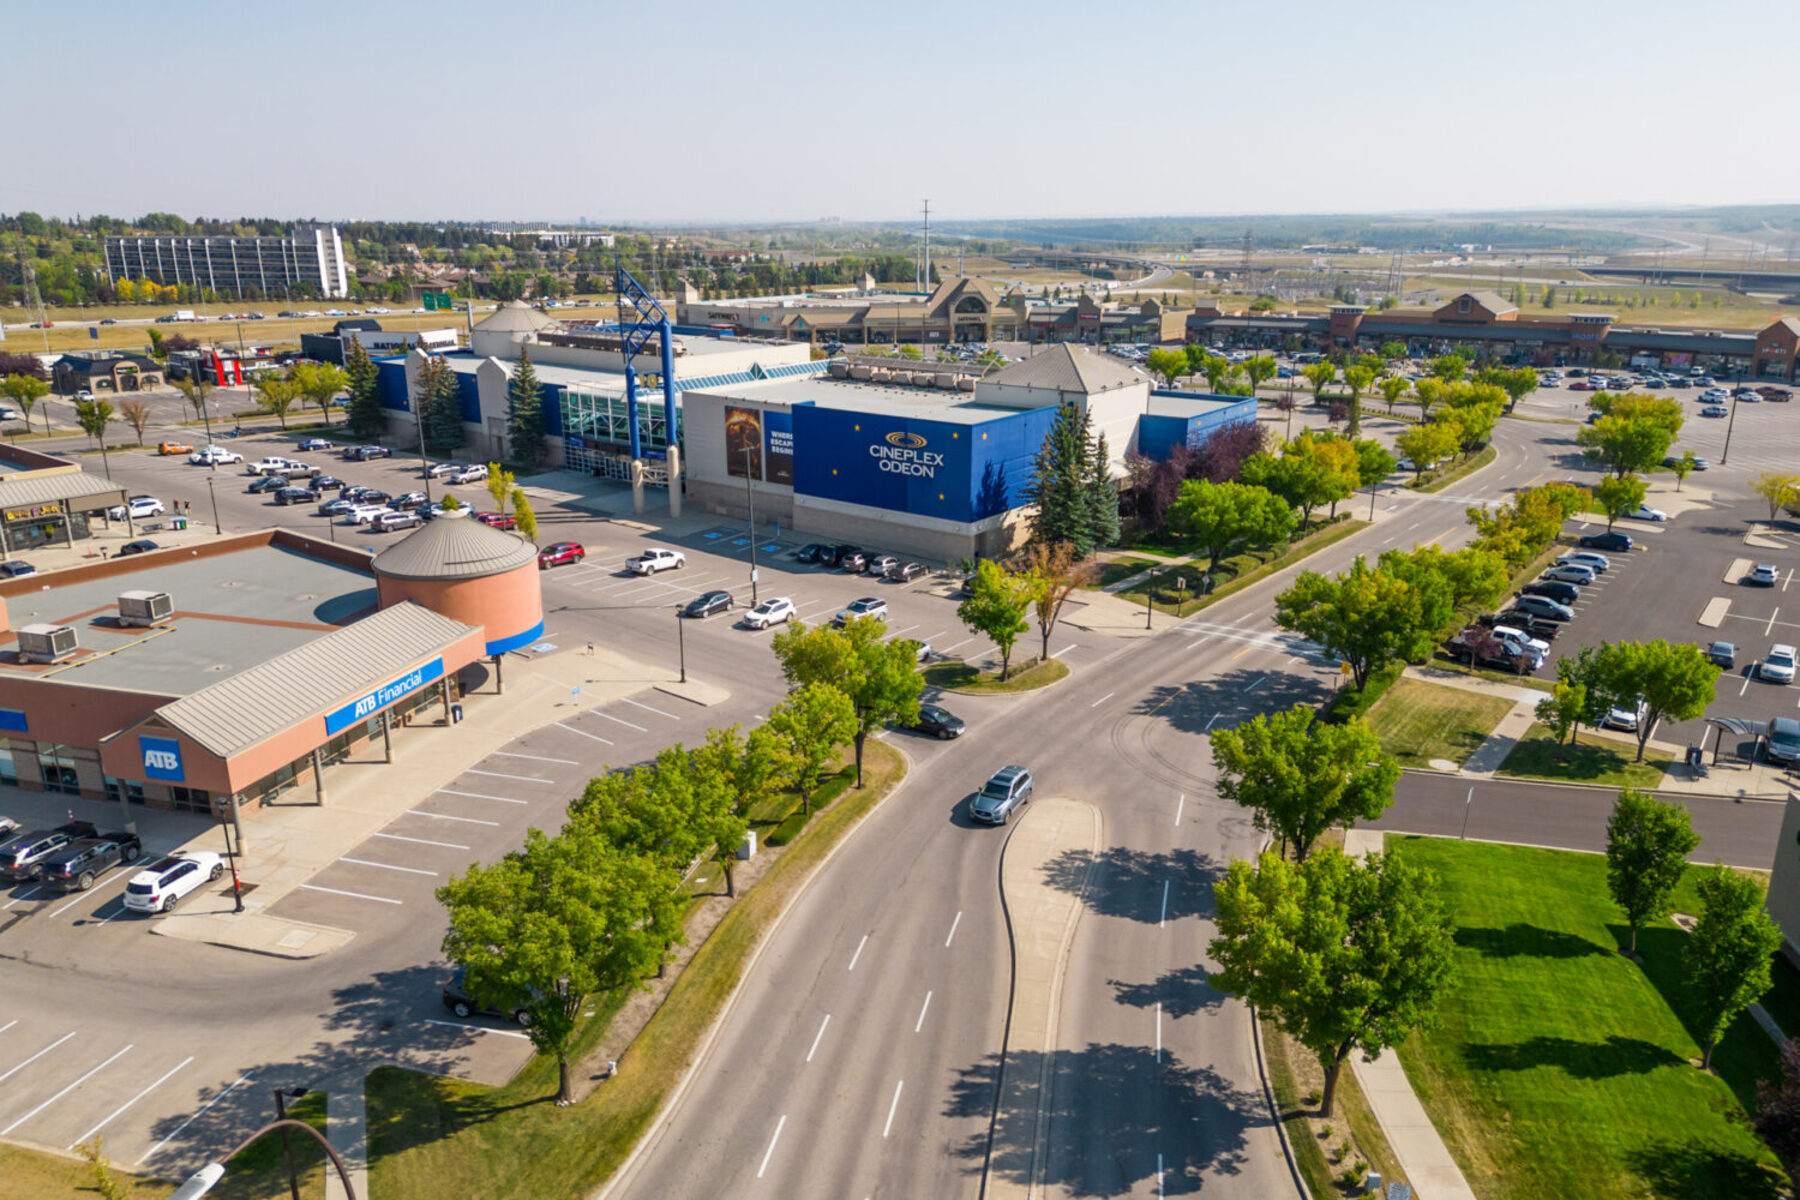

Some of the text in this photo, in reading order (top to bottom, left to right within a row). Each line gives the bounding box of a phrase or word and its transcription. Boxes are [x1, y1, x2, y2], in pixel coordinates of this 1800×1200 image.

[869, 444, 944, 467] CINEPLEX
[879, 459, 934, 478] ODEON
[354, 669, 422, 718] ATB Financial
[145, 750, 178, 770] ATB
